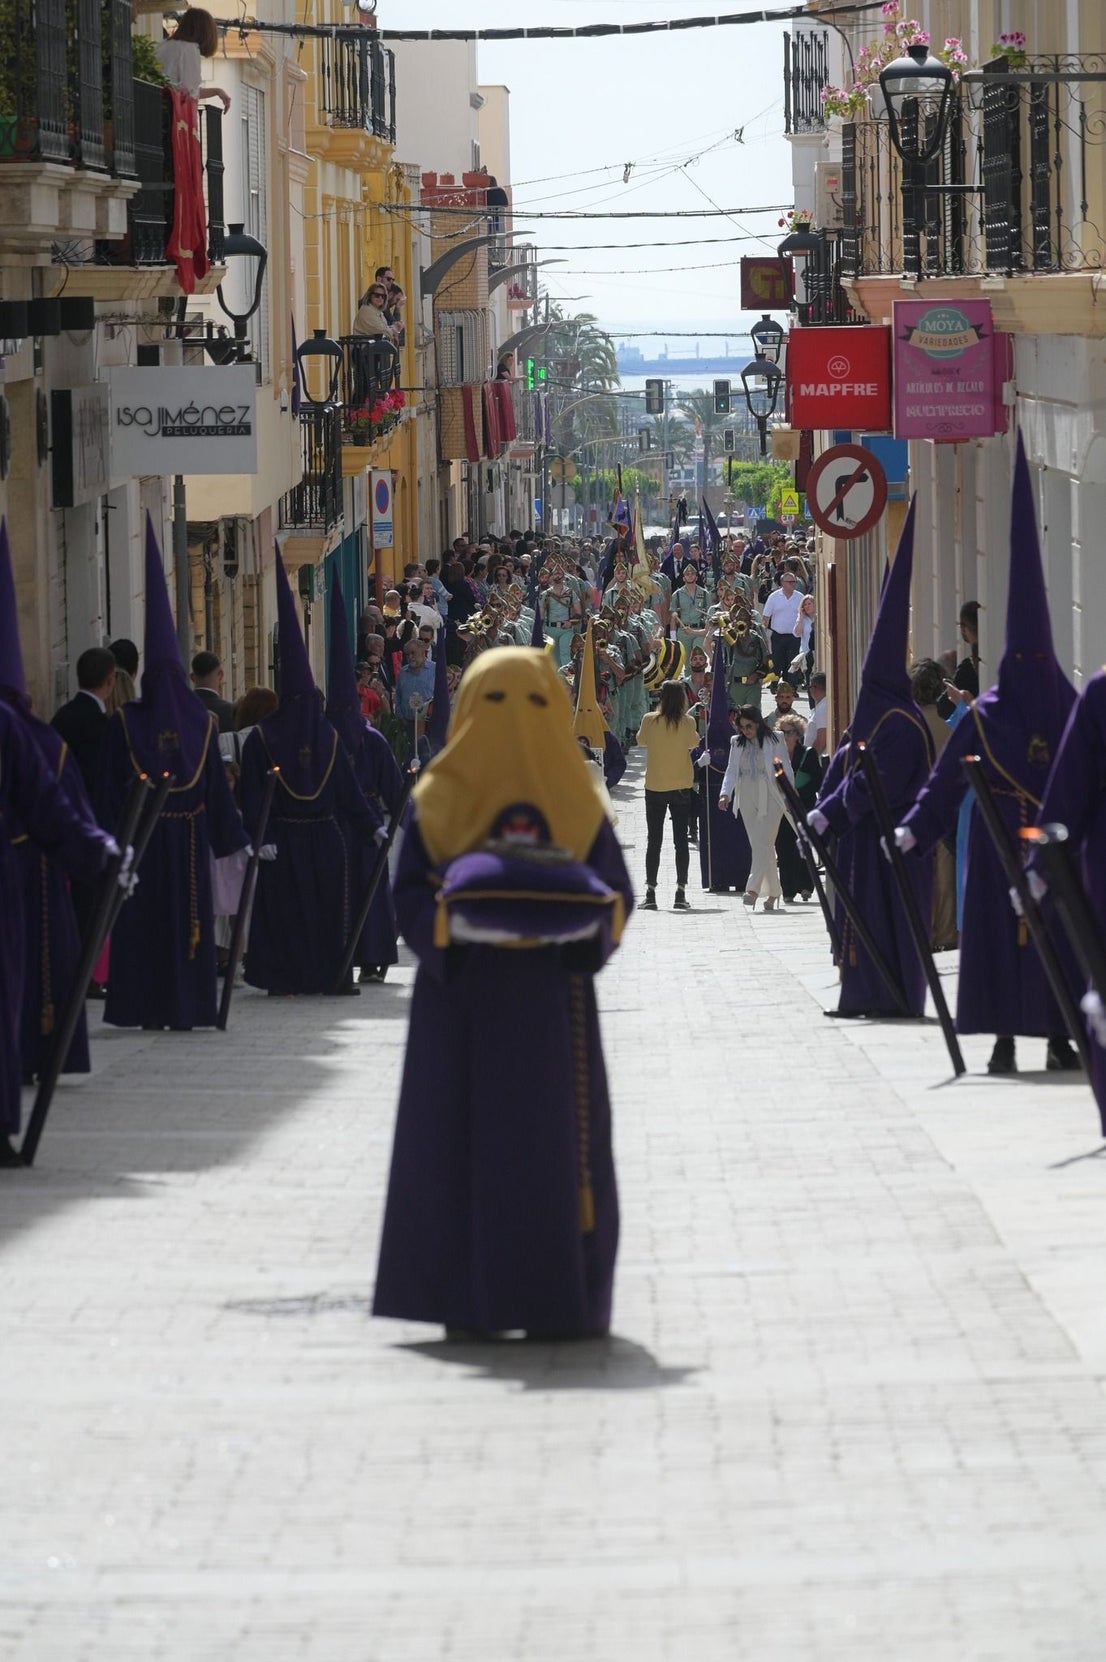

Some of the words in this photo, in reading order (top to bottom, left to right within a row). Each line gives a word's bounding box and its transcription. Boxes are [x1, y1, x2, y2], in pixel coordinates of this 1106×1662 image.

[924, 320, 964, 332] MOYA
[918, 334, 969, 347] VARIEDADES
[800, 383, 878, 396] MAPFRE
[906, 404, 985, 417] MULTIPRECIO
